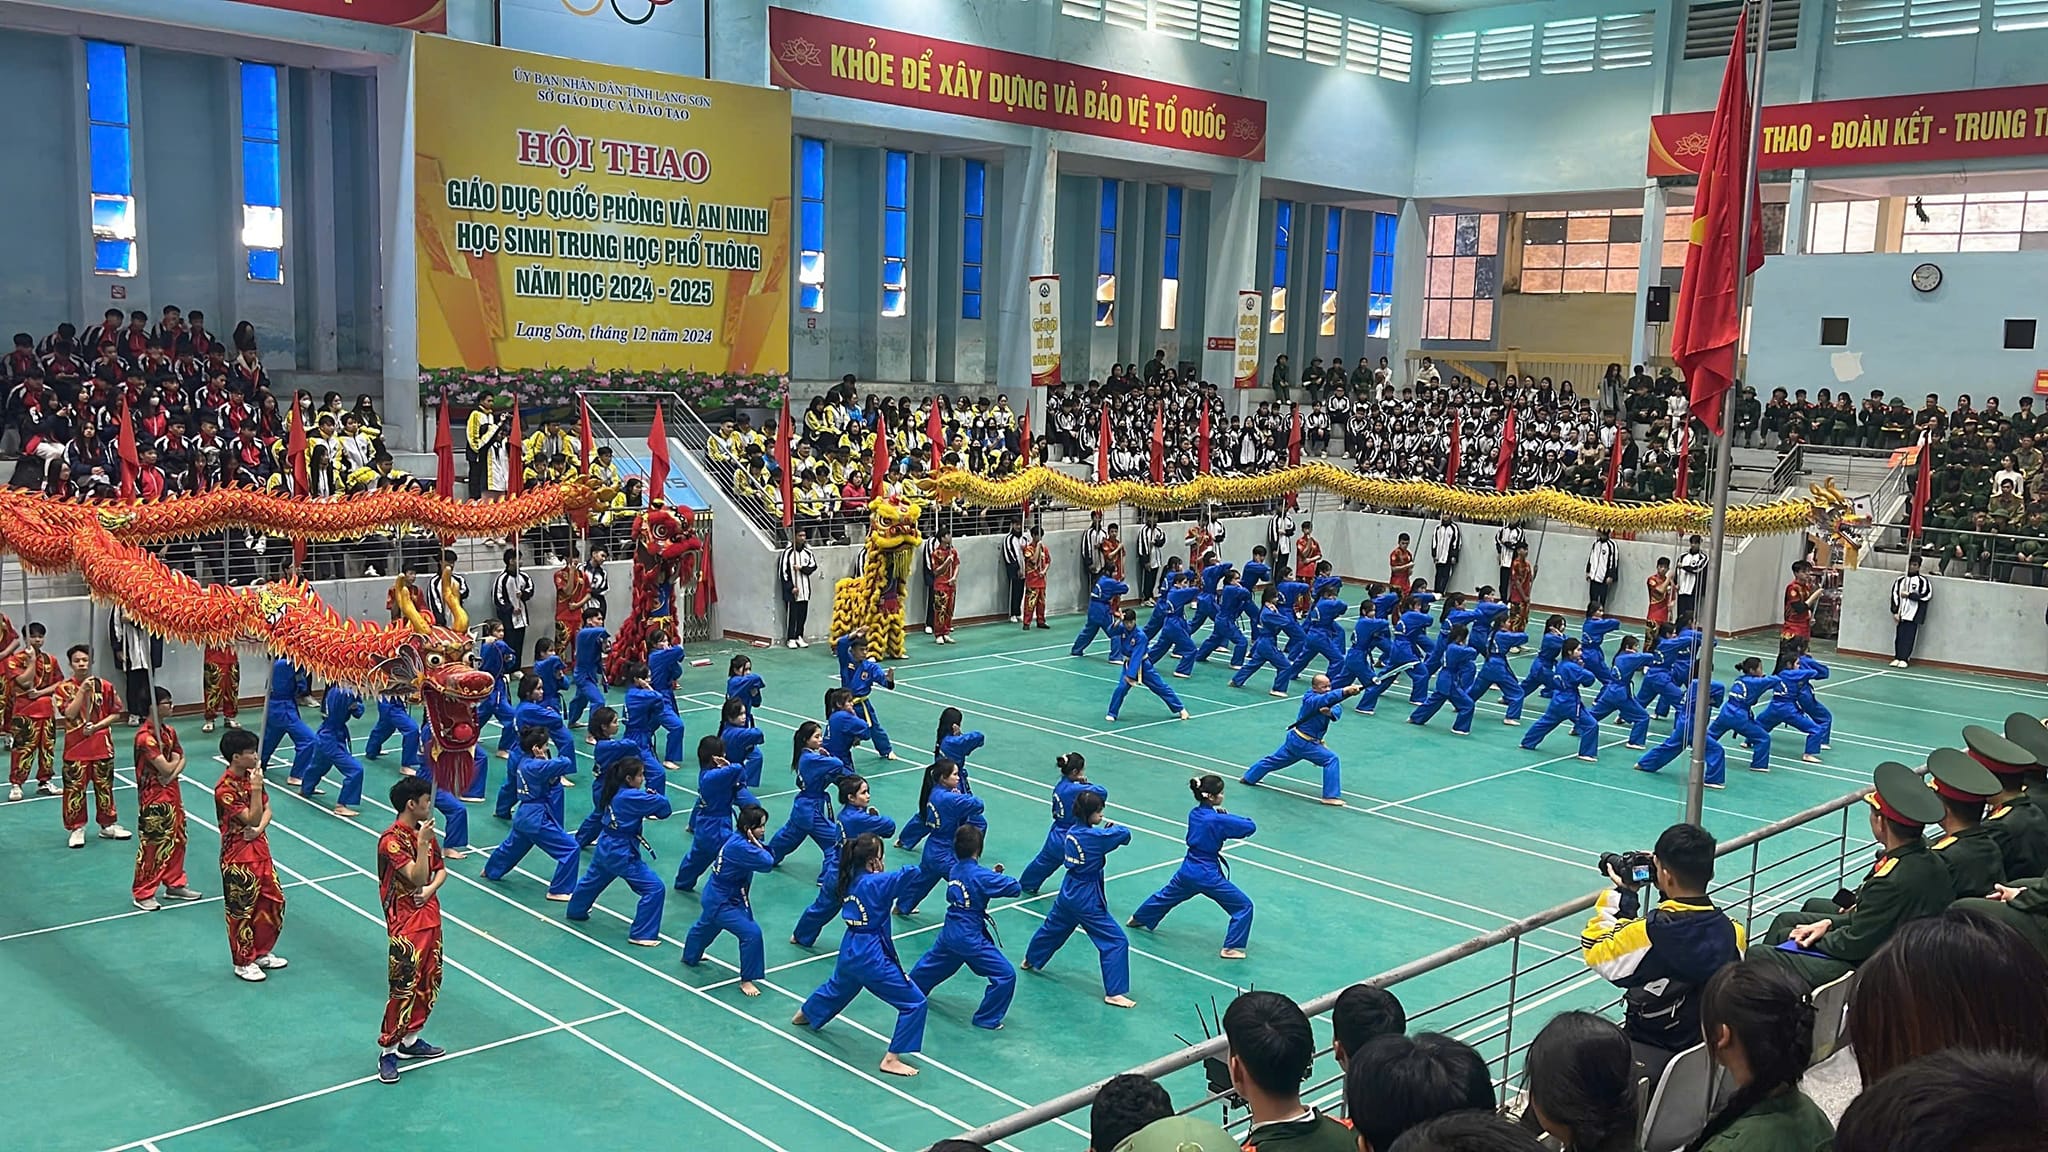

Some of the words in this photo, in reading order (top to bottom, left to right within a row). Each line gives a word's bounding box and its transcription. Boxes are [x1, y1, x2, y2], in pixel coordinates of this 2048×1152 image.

[514, 67, 531, 82] ỦY
[534, 73, 559, 86] BAN
[562, 75, 596, 91] NHÂN
[599, 80, 623, 95] DÂN
[656, 91, 687, 105] LẠNG
[689, 94, 711, 107] SƠN
[538, 88, 554, 102] SỞ
[557, 91, 588, 107] GIÁO
[591, 96, 615, 112] DỤC
[619, 99, 635, 113] VÀ
[638, 102, 663, 117] ĐÀO
[665, 107, 690, 120] TẠO
[830, 37, 895, 87] KHỎE
[902, 48, 933, 93] ĐỂ
[938, 60, 983, 100] XÂY
[989, 72, 1047, 112] DỰNG
[1053, 80, 1079, 116] VÀ
[1084, 80, 1122, 123] BẢO
[1128, 93, 1149, 134] VỆ
[1155, 94, 1178, 133] TỔ
[1181, 103, 1227, 141] QUỐC
[1763, 123, 1812, 154] THAO
[1831, 114, 1888, 149] ĐOÀN
[1893, 106, 1934, 146] KẾT
[1954, 109, 2027, 142] TRUNG
[2034, 107, 2048, 137] T
[518, 127, 593, 177] HỘI
[602, 142, 709, 181] THAO
[447, 176, 495, 209] GIÁO
[502, 185, 541, 217] DỤC
[547, 184, 597, 218] QUỐC
[603, 192, 664, 223] PHÒNG
[670, 198, 692, 226] VÀ
[697, 205, 721, 228] AN
[726, 207, 767, 233] NINH
[457, 223, 498, 255] HỌC
[504, 227, 550, 254] SINH
[557, 231, 618, 259] TRUNG
[624, 236, 659, 267] HỌC
[665, 233, 701, 265] PHỔ
[704, 240, 760, 269] THÔNG
[516, 265, 560, 295] NĂM
[567, 273, 604, 302] HỌC
[610, 275, 653, 300] 2024
[670, 279, 712, 304] 2025
[516, 322, 552, 340] Lạng
[556, 323, 585, 340] Sơn,
[590, 325, 628, 343] tháng
[633, 327, 647, 341] 12
[651, 329, 678, 342] năm
[682, 329, 712, 343] 2024
